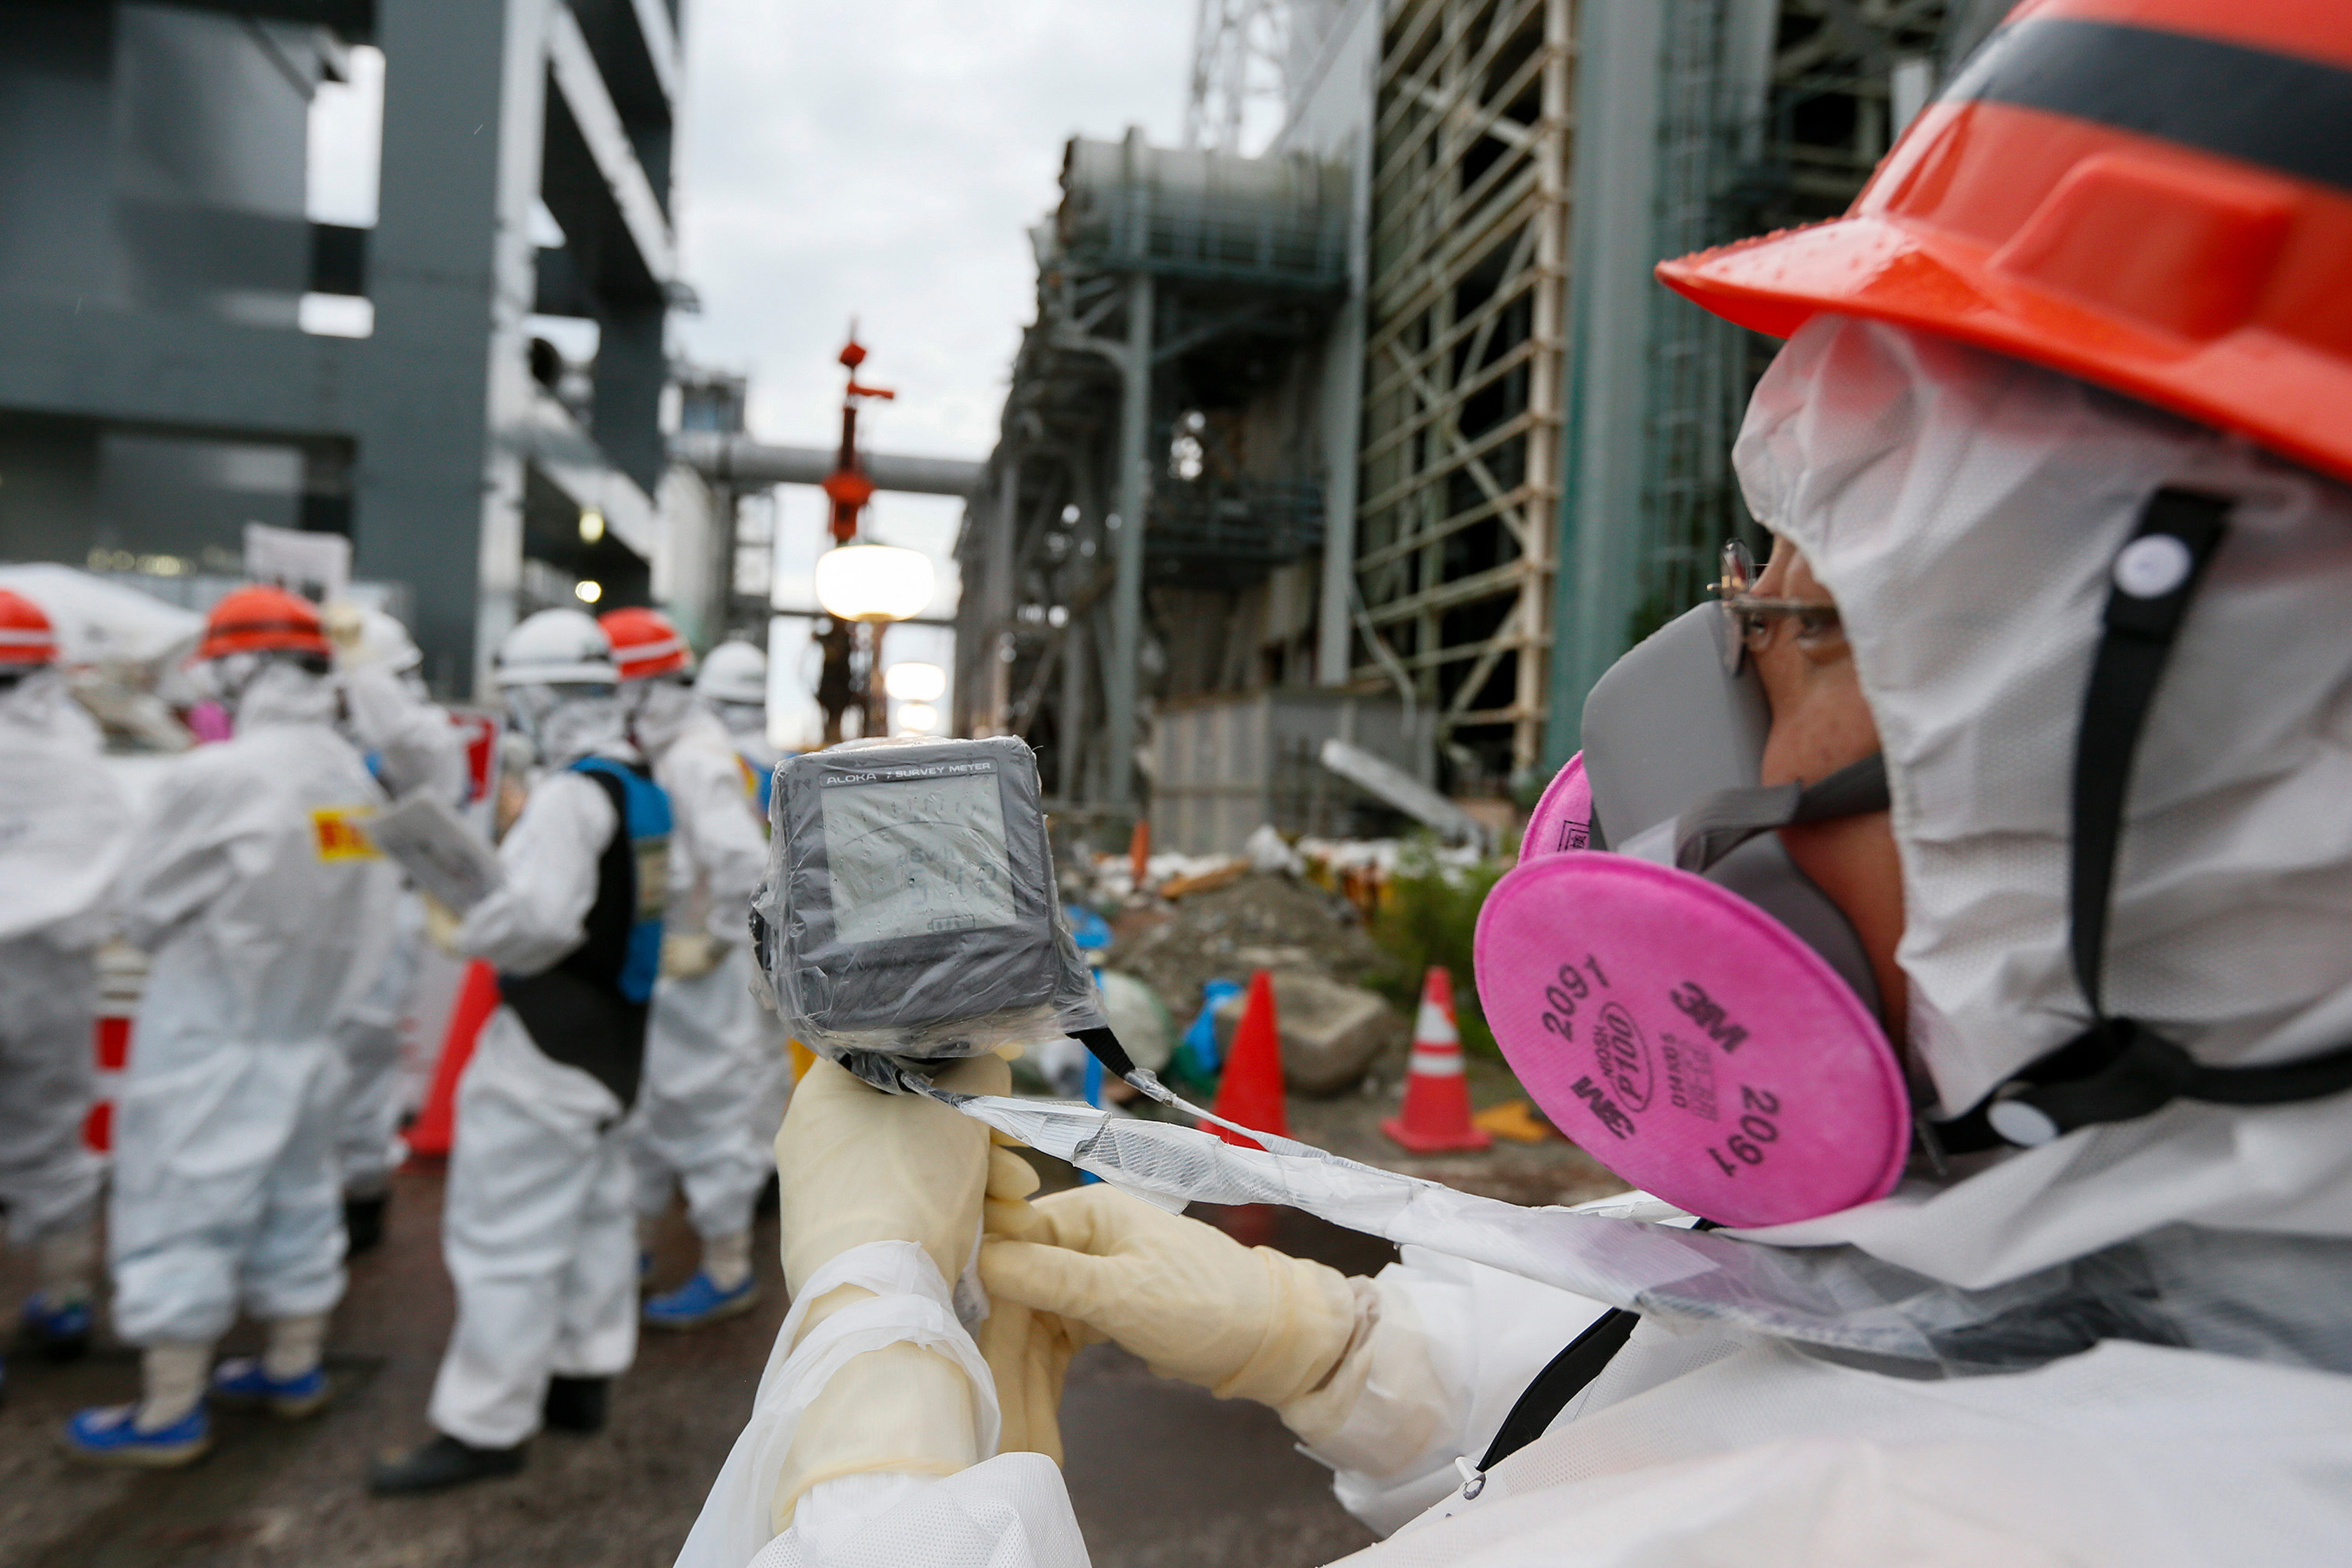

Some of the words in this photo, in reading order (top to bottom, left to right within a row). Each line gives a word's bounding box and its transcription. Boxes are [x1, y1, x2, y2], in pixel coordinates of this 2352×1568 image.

[826, 773, 876, 785] ALOKA
[895, 767, 944, 778] SURVEY
[949, 763, 991, 773] METER
[1542, 954, 1610, 1042] 2091
[1669, 981, 1749, 1054] 3M
[1593, 1025, 1613, 1078] NIOSH
[1607, 1014, 1642, 1101] P100
[1570, 1076, 1635, 1140] 3M
[1708, 1085, 1780, 1178] 2091
